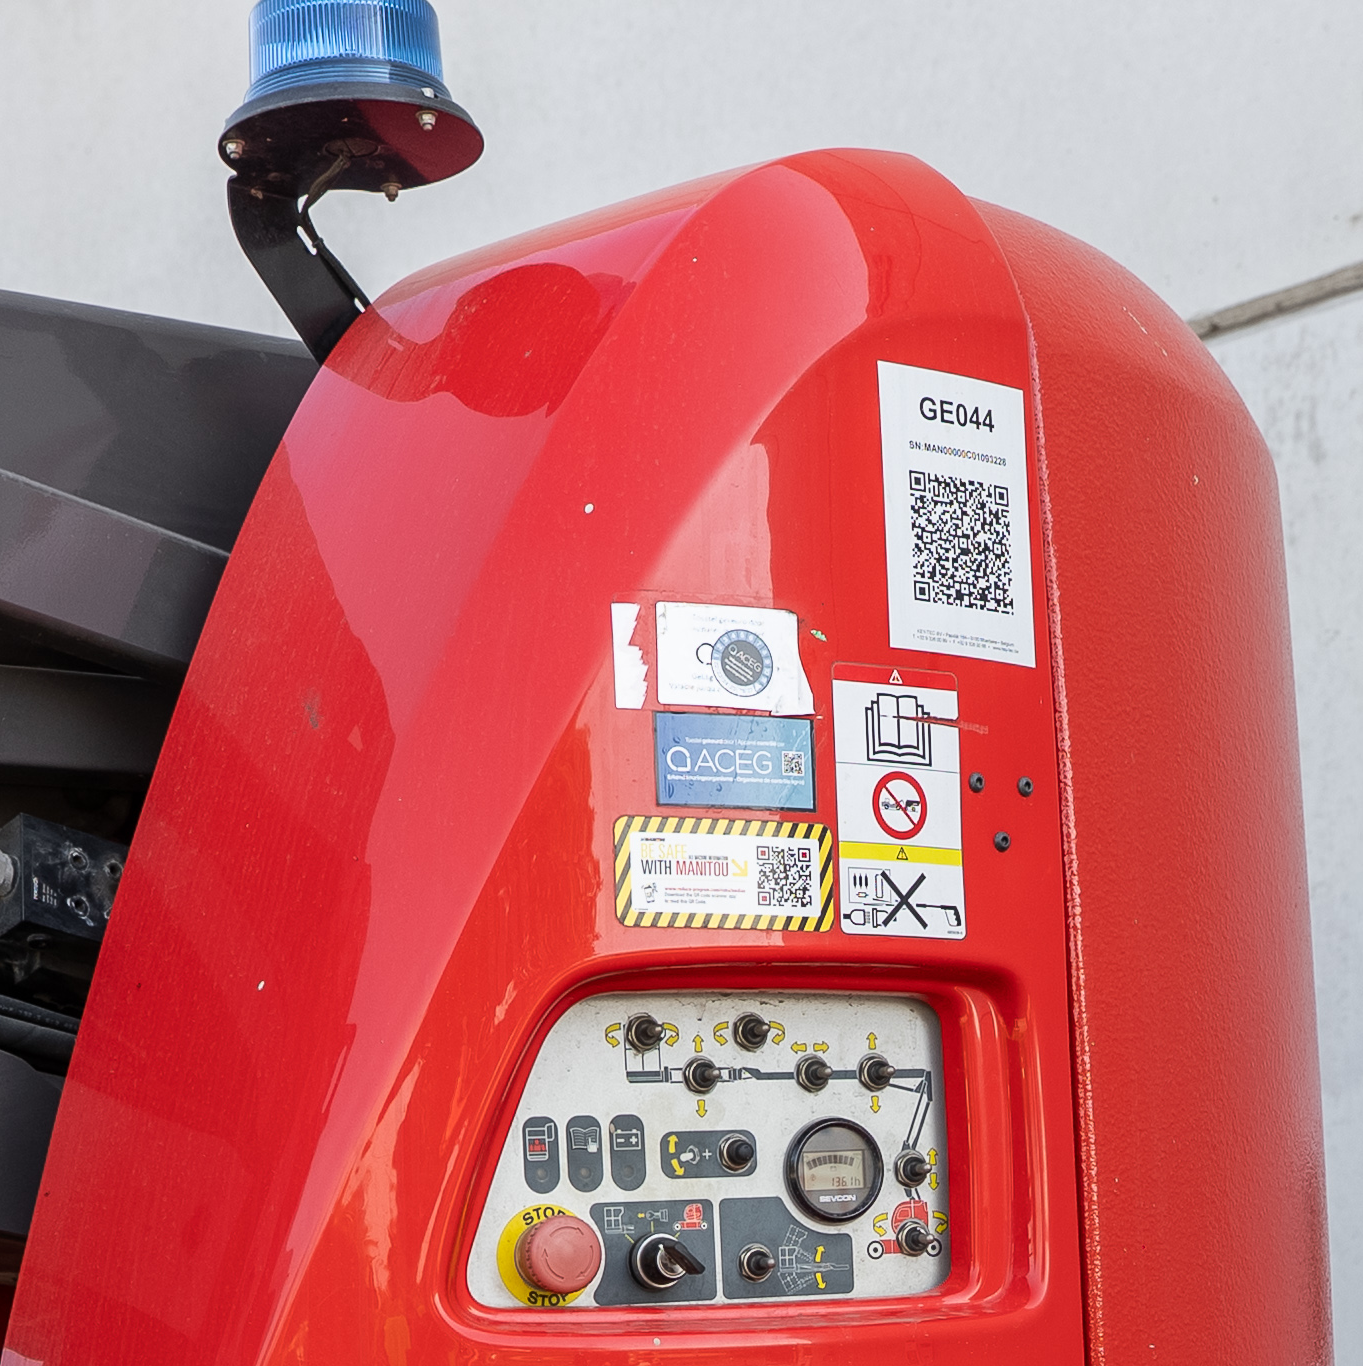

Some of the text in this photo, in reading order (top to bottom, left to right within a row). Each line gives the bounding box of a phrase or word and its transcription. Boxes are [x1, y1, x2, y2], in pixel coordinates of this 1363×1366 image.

[919, 396, 995, 433] GE044
[640, 843, 687, 860] BE SAFE
[641, 859, 729, 877] WITH MANITOU
